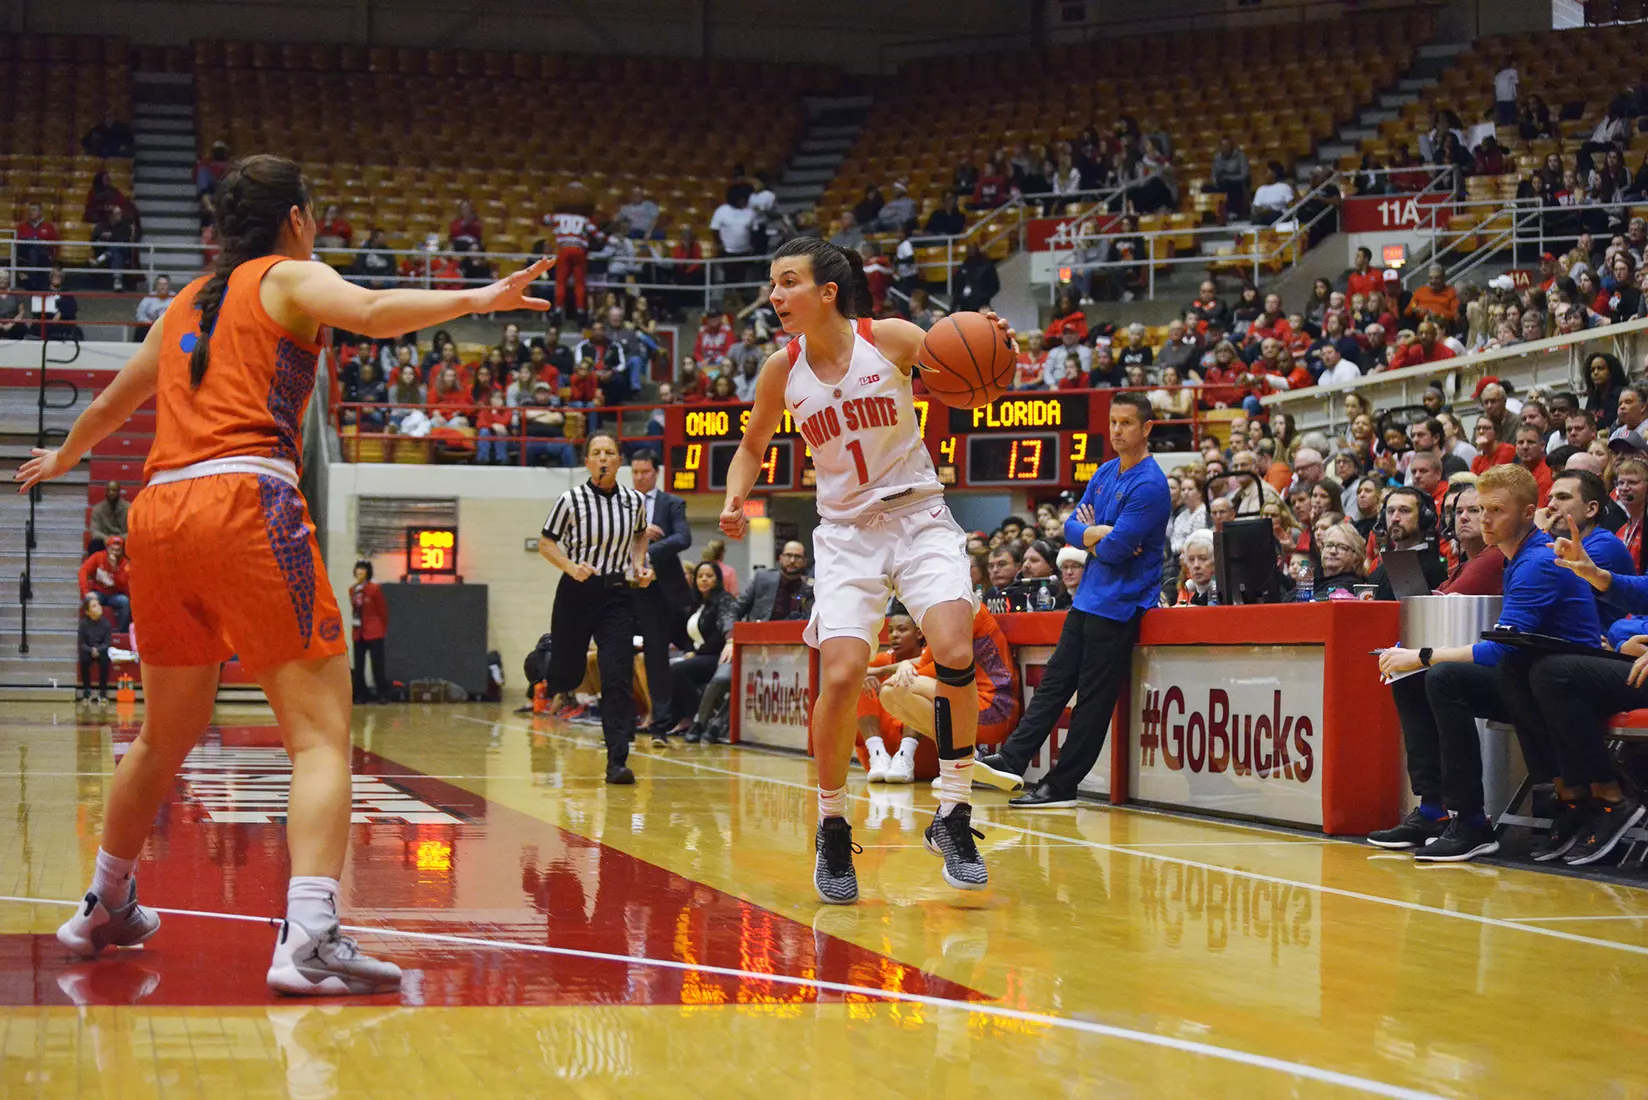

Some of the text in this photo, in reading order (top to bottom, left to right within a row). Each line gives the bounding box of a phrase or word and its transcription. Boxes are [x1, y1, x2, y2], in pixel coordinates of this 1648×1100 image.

[1377, 199, 1421, 226] 11A
[685, 411, 729, 437] OHIO
[801, 405, 842, 449] OHIO
[841, 396, 899, 432] STATE
[972, 399, 1061, 428] FLORIDA
[940, 437, 957, 464] 4
[1008, 440, 1043, 479] 13
[1069, 433, 1088, 461] 3
[845, 439, 870, 486] 1
[420, 548, 444, 569] 30
[745, 669, 809, 727] #GoBucks
[1140, 685, 1314, 783] #GoBucks
